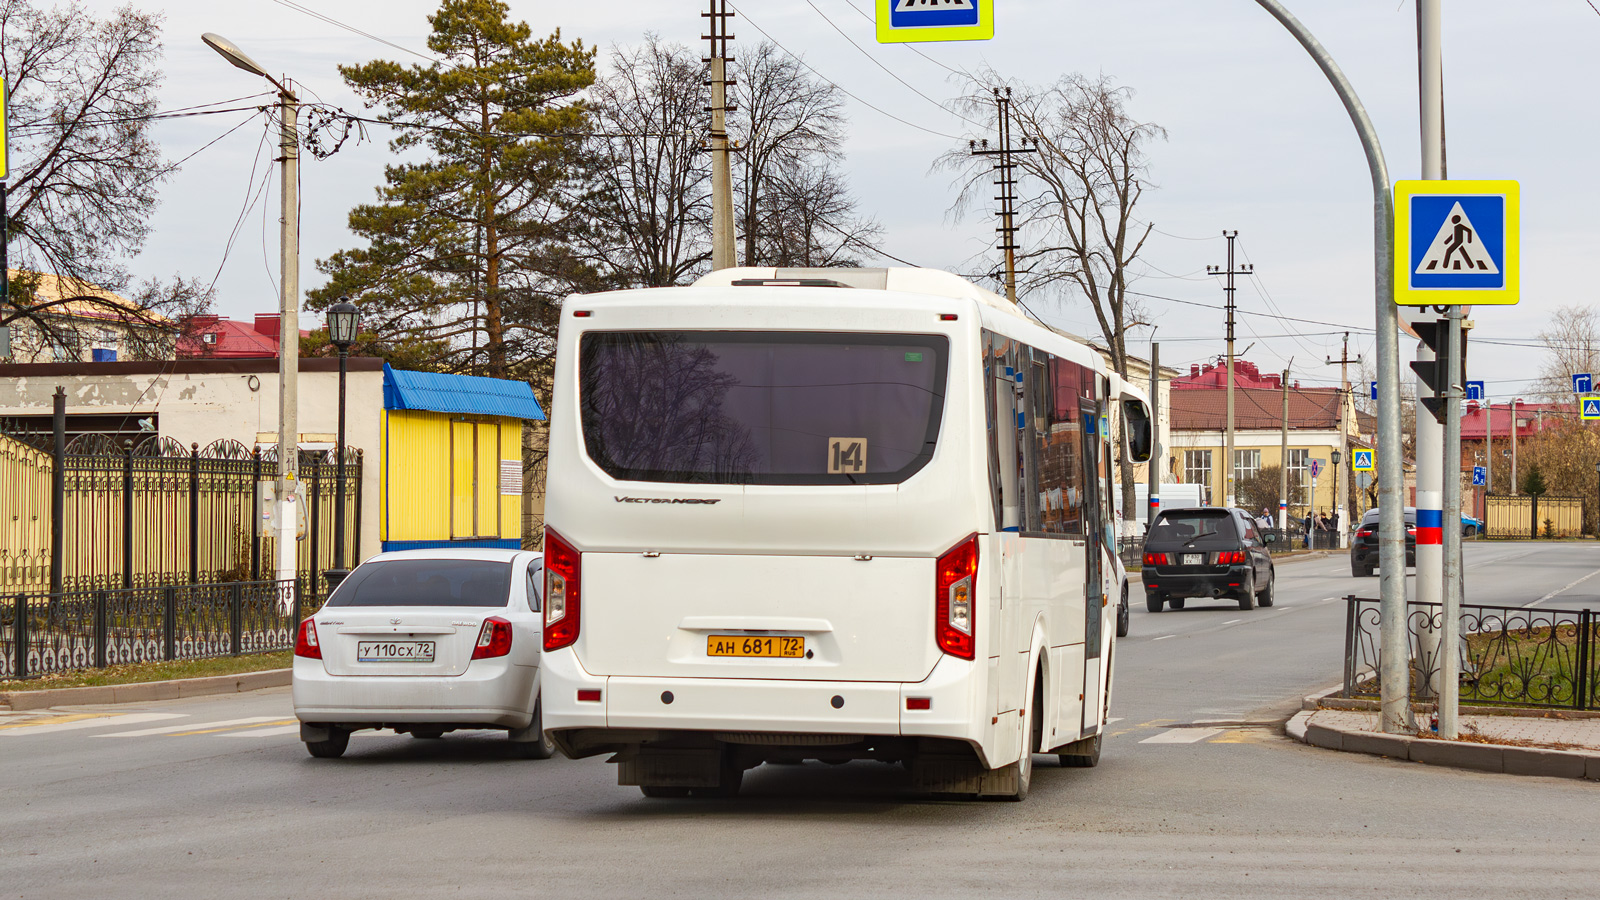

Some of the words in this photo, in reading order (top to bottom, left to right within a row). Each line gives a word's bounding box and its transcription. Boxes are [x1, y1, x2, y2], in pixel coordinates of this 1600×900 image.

[832, 441, 863, 472] 14
[417, 643, 430, 654] 72
[742, 638, 772, 654] 681
[783, 638, 798, 651] 72
